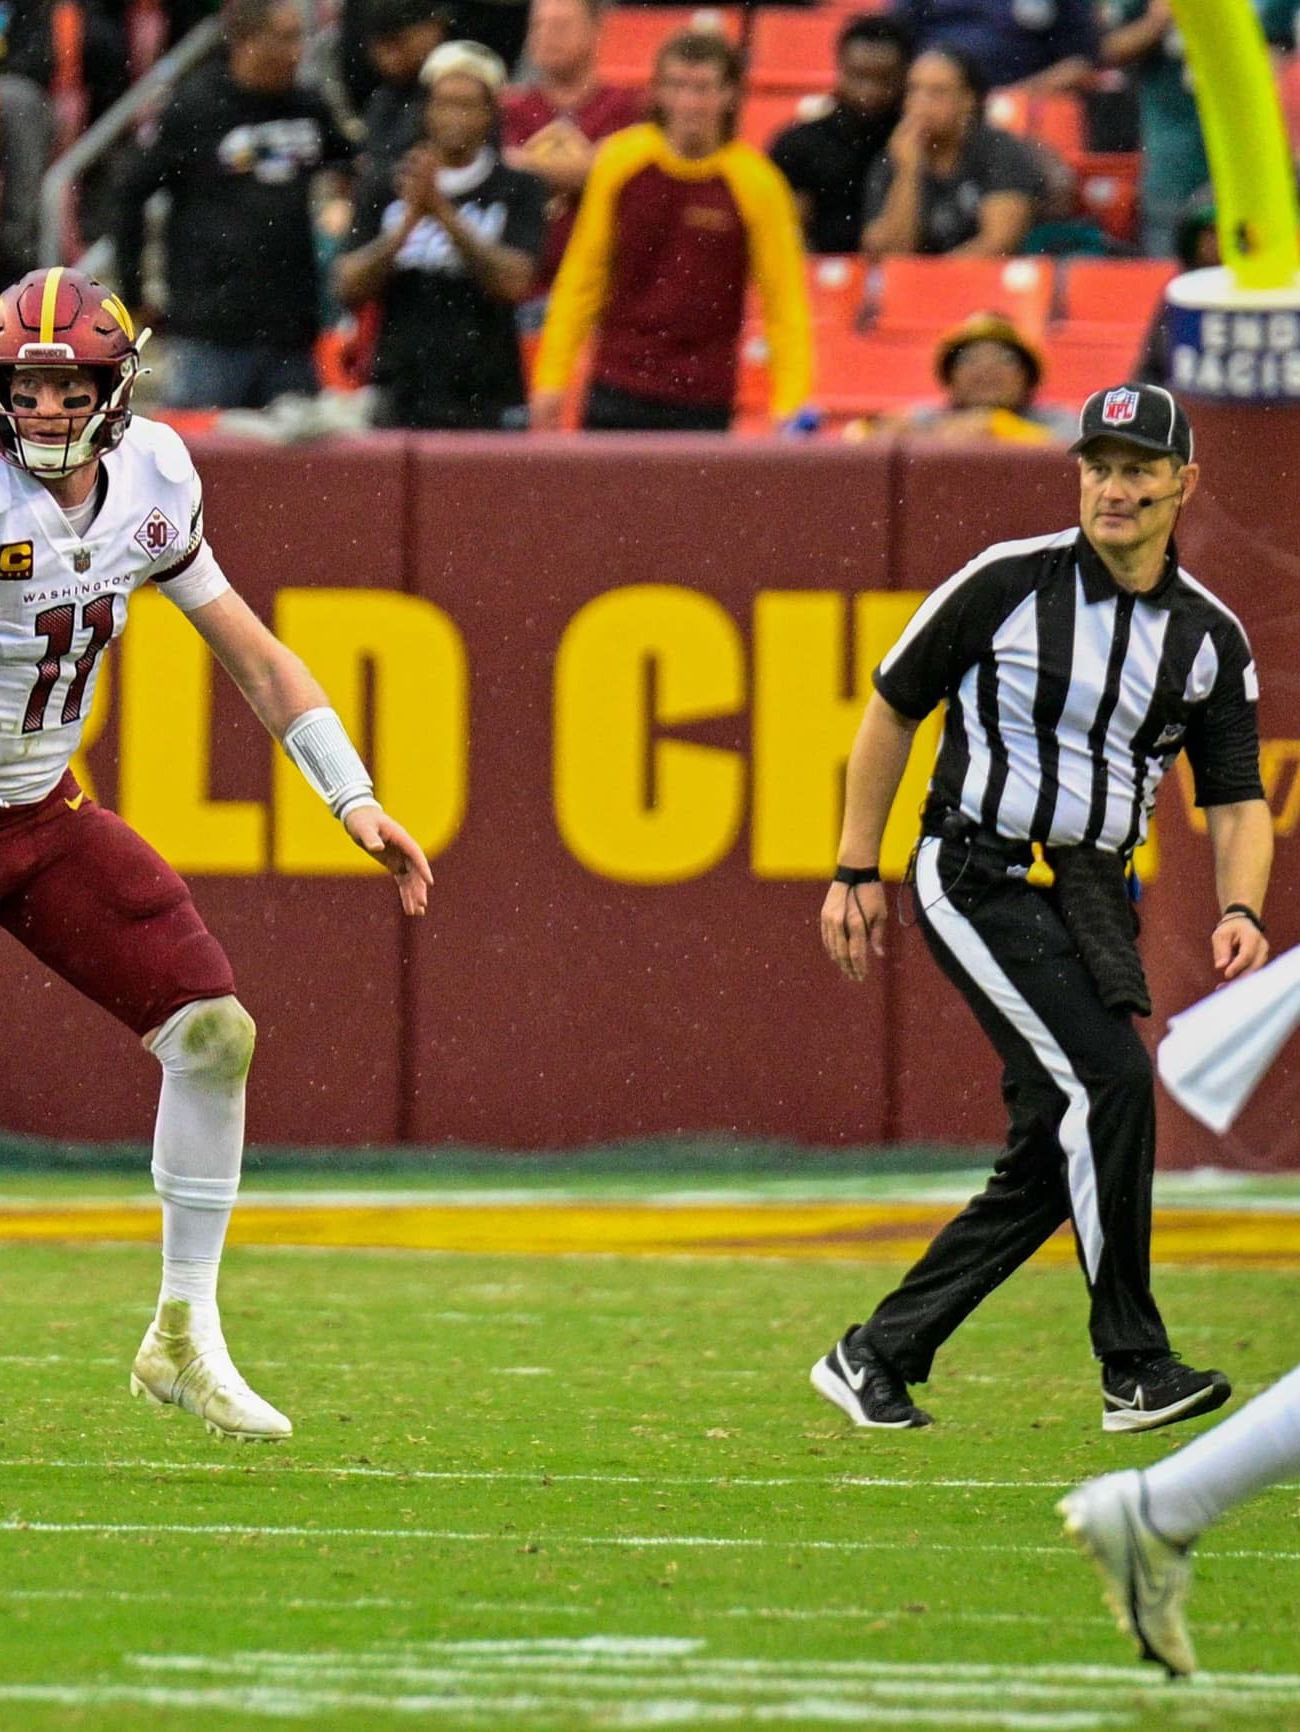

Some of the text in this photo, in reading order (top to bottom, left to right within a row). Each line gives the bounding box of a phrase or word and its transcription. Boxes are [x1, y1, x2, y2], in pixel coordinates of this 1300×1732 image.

[1201, 310, 1294, 352] END
[1106, 404, 1134, 420] NFL
[146, 521, 167, 548] 90
[0, 543, 32, 572] C
[23, 573, 132, 603] WASHINGTON
[22, 592, 117, 734] 11
